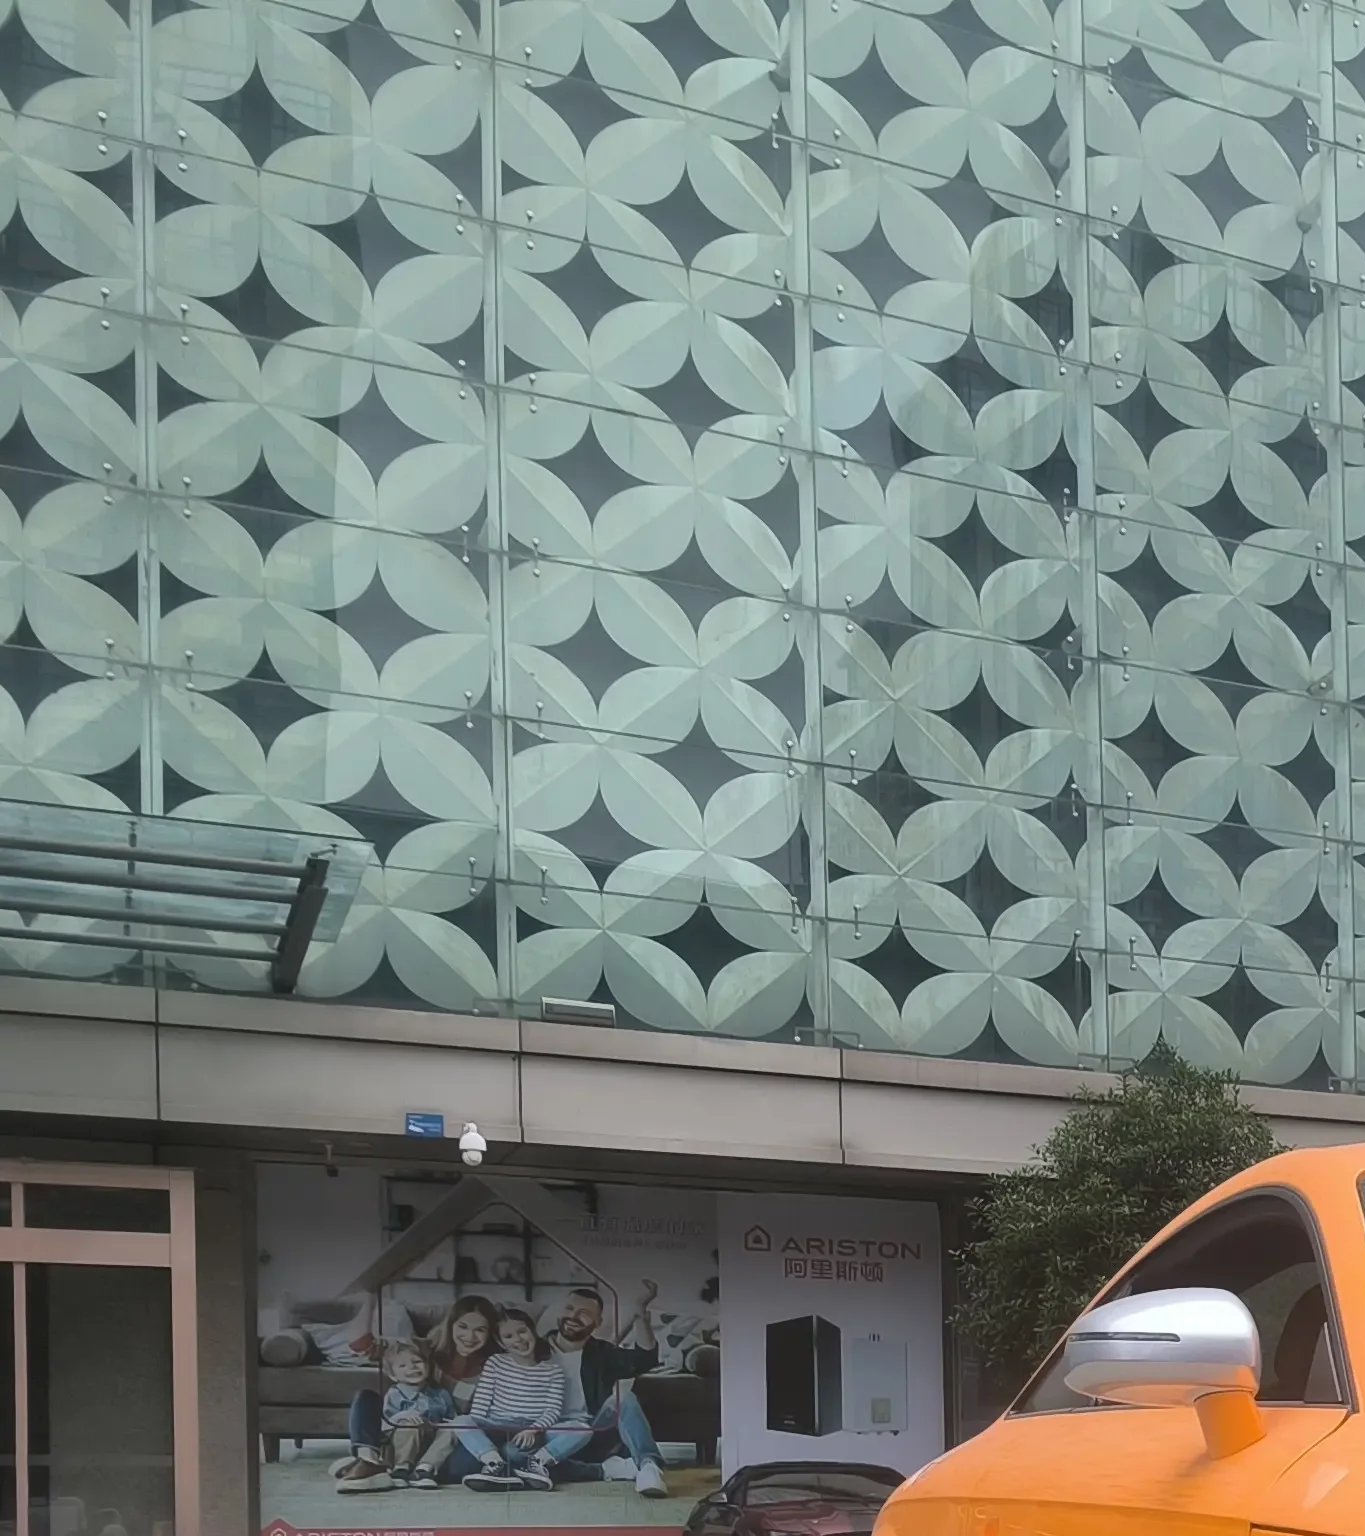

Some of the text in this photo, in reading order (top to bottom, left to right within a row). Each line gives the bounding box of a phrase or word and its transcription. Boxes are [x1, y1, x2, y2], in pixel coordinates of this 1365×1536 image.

[781, 1236, 922, 1260] ARISTON
[784, 1257, 884, 1283] 阿里斯顿
